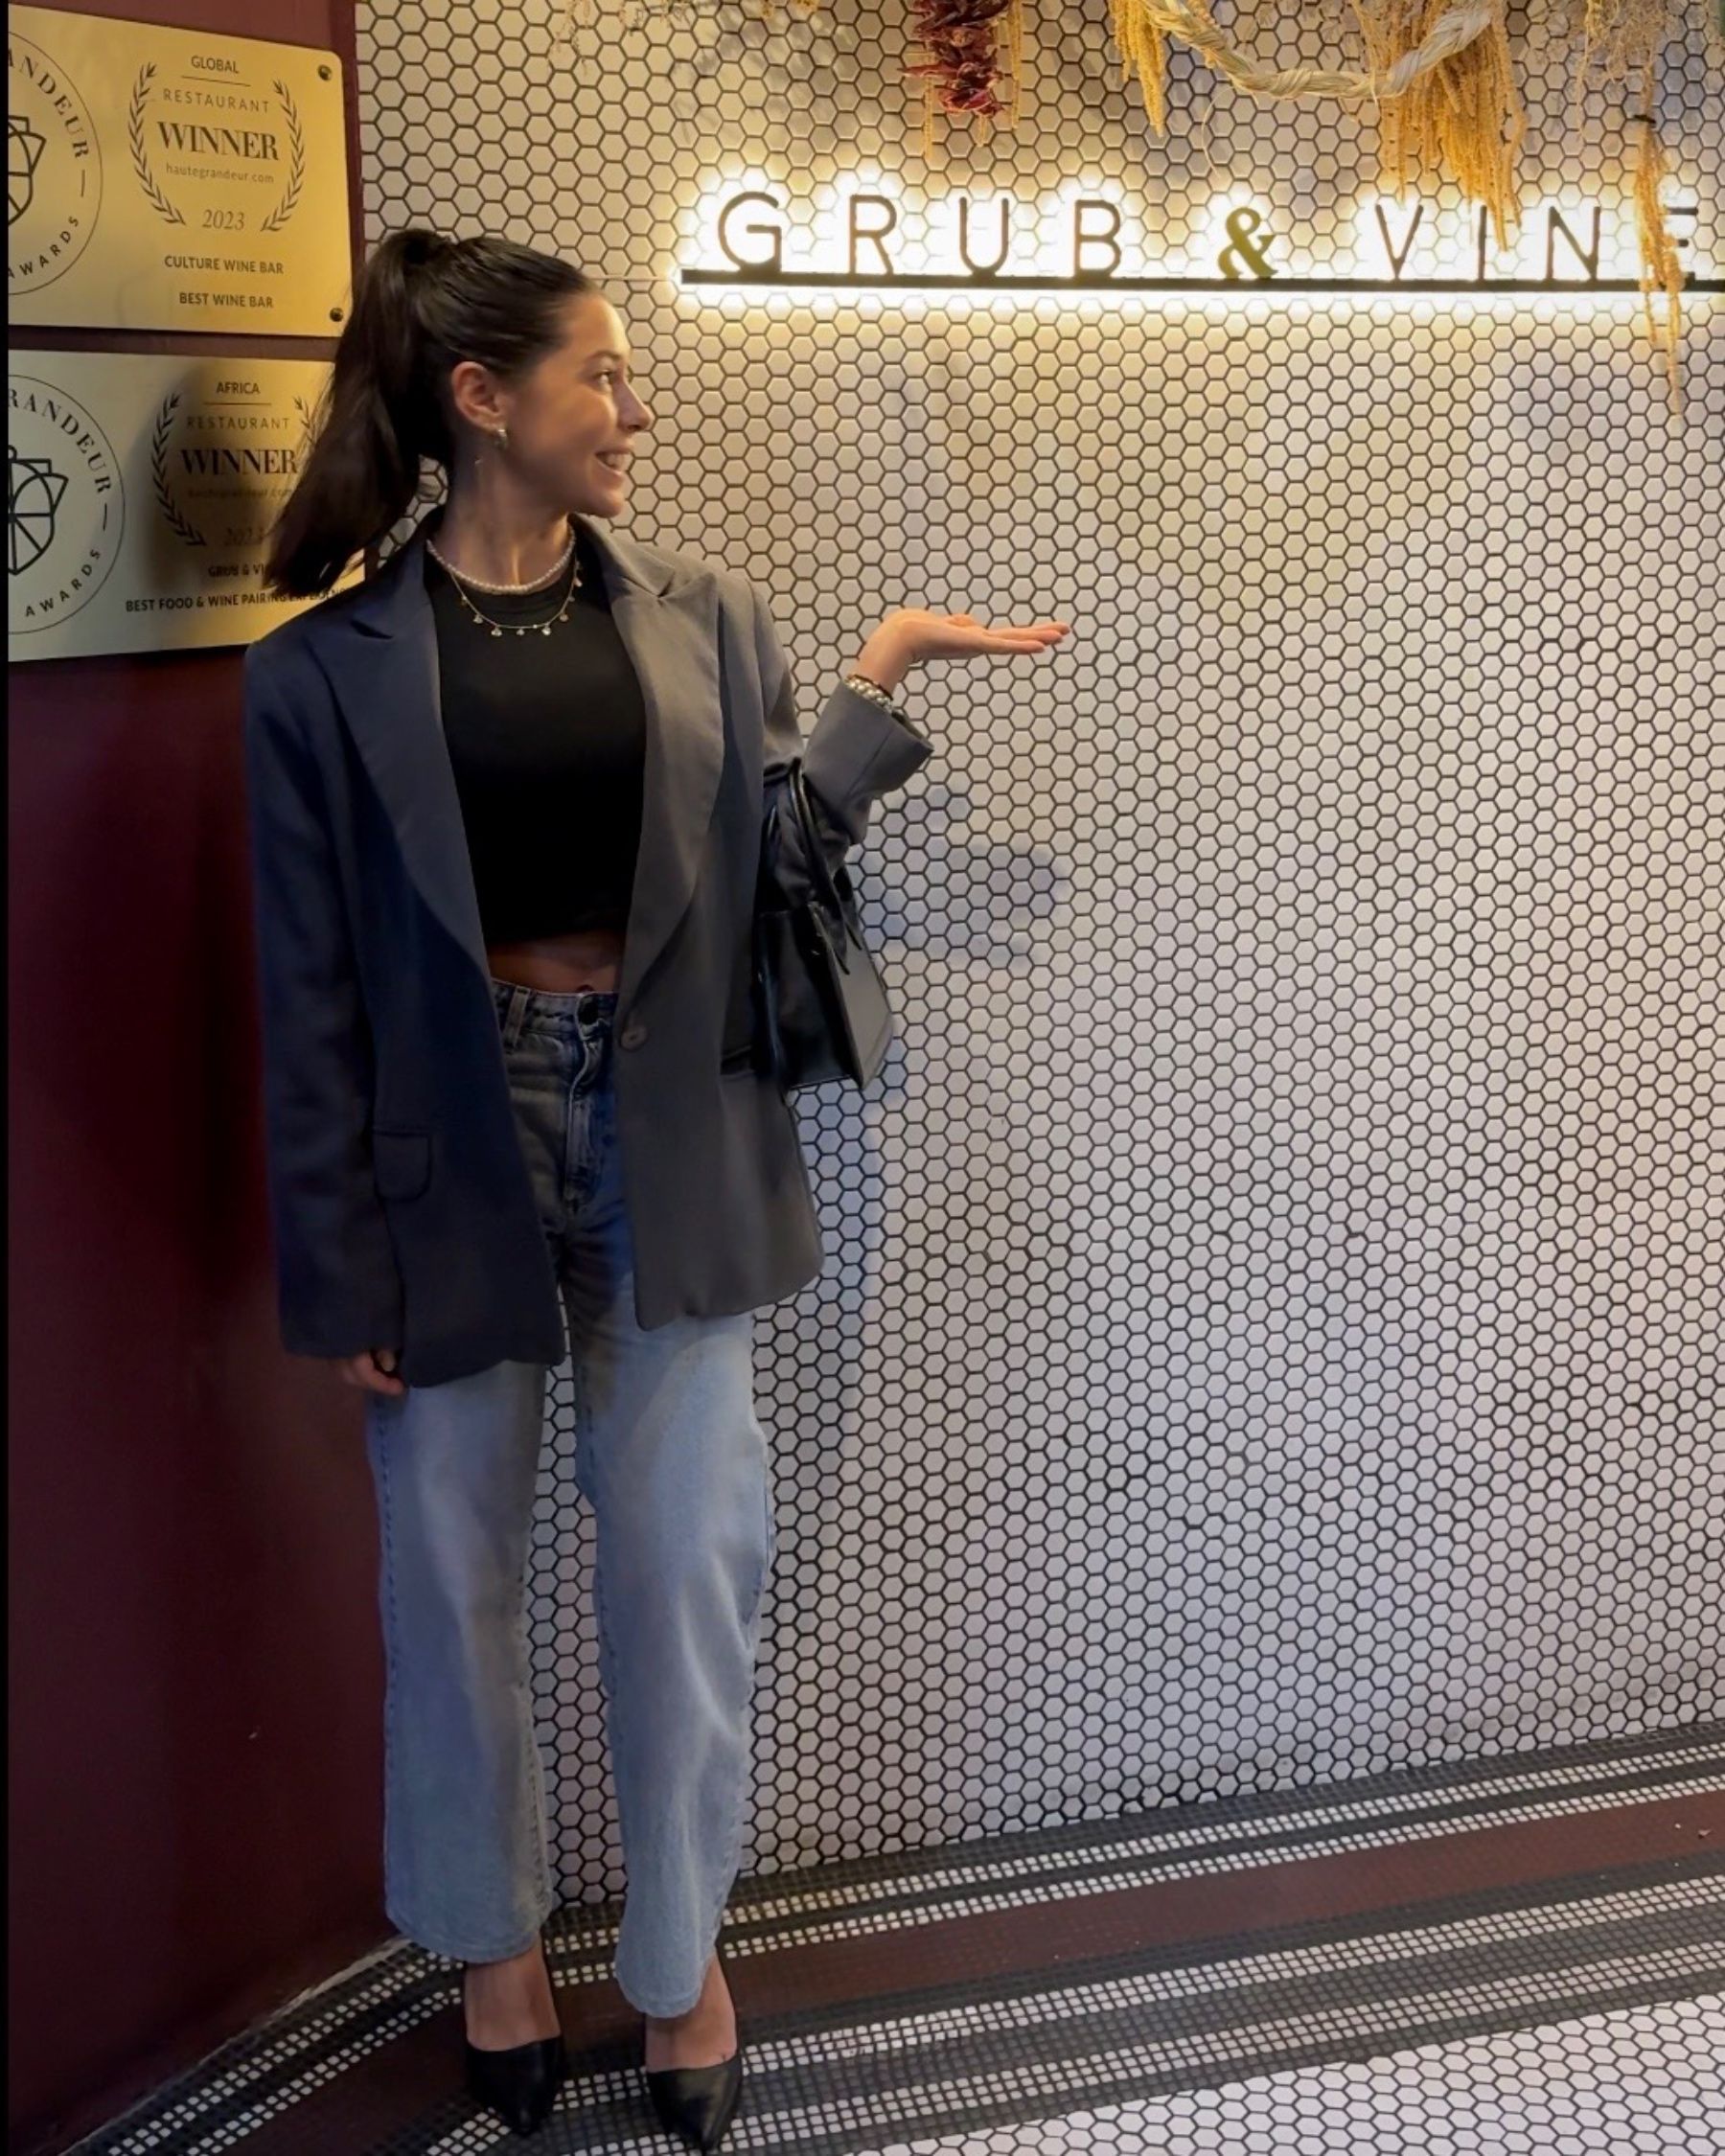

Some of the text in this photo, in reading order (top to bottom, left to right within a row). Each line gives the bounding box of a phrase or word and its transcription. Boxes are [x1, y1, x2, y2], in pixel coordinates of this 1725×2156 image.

[191, 55, 240, 74] GLOBAL
[163, 87, 269, 113] RESTAURANT
[157, 121, 280, 161] WINNER
[202, 208, 245, 231] 2023
[718, 191, 1122, 278] GRUB
[1217, 207, 1278, 280] &
[164, 255, 285, 275] CULTURE WINE BAR
[179, 292, 274, 309] BEST WINE BAR
[216, 381, 261, 395] AFRICA
[187, 416, 290, 430] RESTAURANT
[180, 448, 298, 476] WINNER
[25, 549, 101, 617] AWARDS
[126, 599, 155, 612] BEST
[159, 597, 193, 610] FOOD
[196, 595, 204, 608] &
[207, 594, 239, 607] WINE
